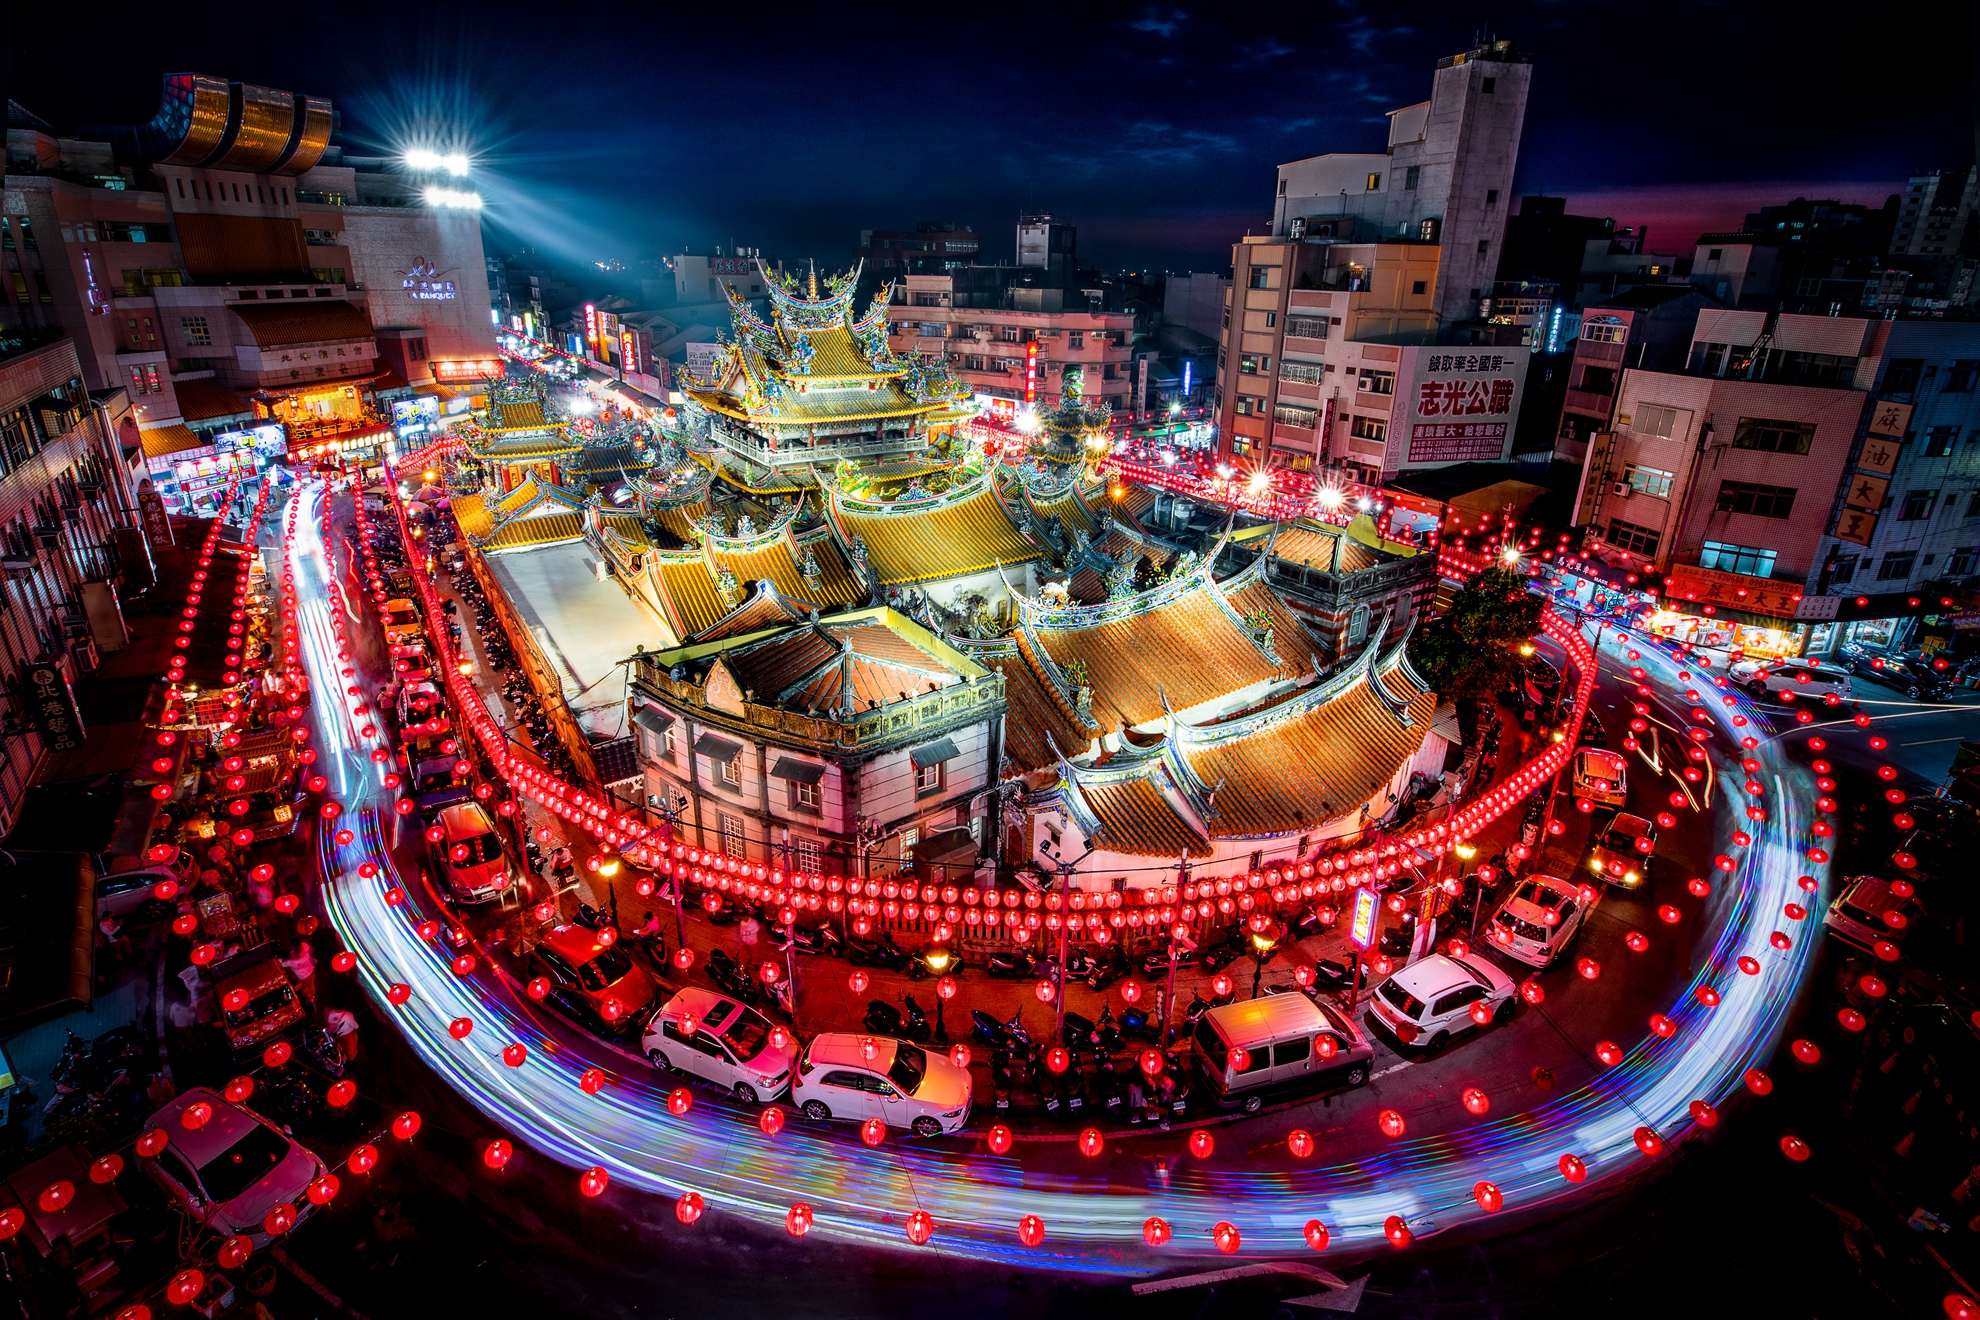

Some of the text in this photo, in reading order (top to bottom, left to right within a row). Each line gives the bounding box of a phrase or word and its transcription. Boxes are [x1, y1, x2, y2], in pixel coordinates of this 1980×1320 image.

[1427, 355, 1515, 373] 錄取率全國第一
[1418, 380, 1514, 417] 志光公職
[1593, 576, 1609, 586] MARK
[1701, 570, 1745, 585] 05-7830688
[1748, 577, 1800, 593] 0963-156185
